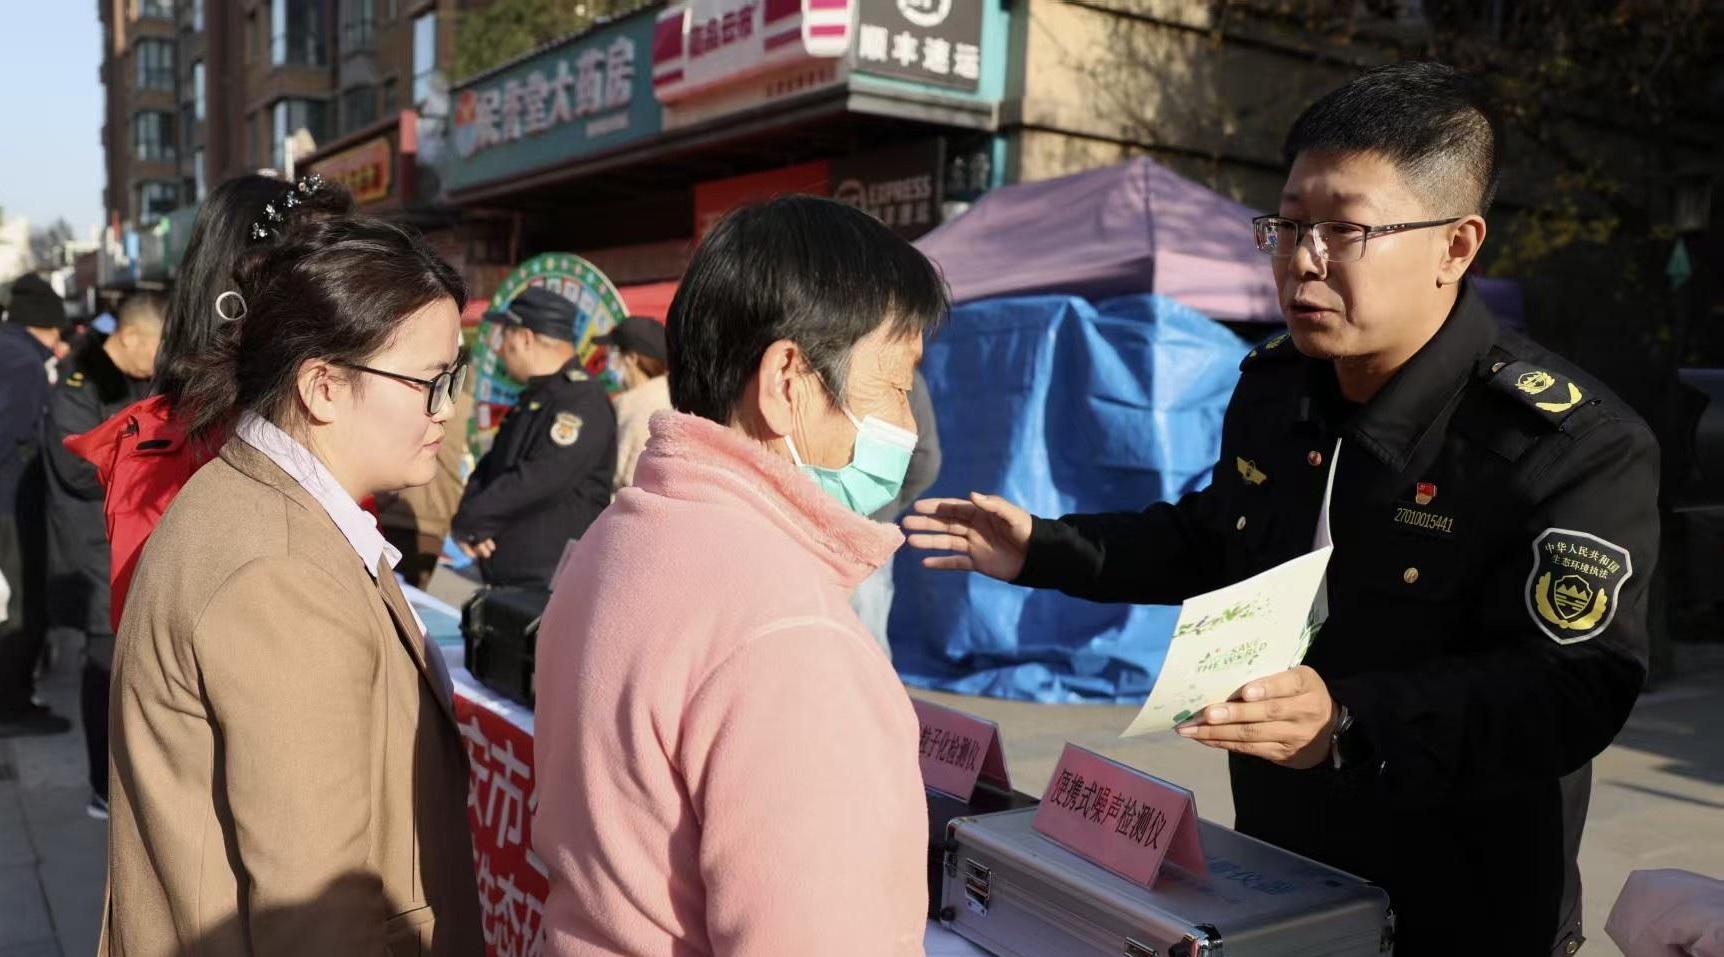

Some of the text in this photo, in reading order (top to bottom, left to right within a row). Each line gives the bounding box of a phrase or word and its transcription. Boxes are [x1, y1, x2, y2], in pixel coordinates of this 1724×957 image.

[1394, 507, 1454, 533] 27010015441
[1545, 541, 1620, 574] 中华人民共和国
[1552, 554, 1609, 580] 生态环境执法
[1050, 767, 1167, 850] 便携式噪声检测仪
